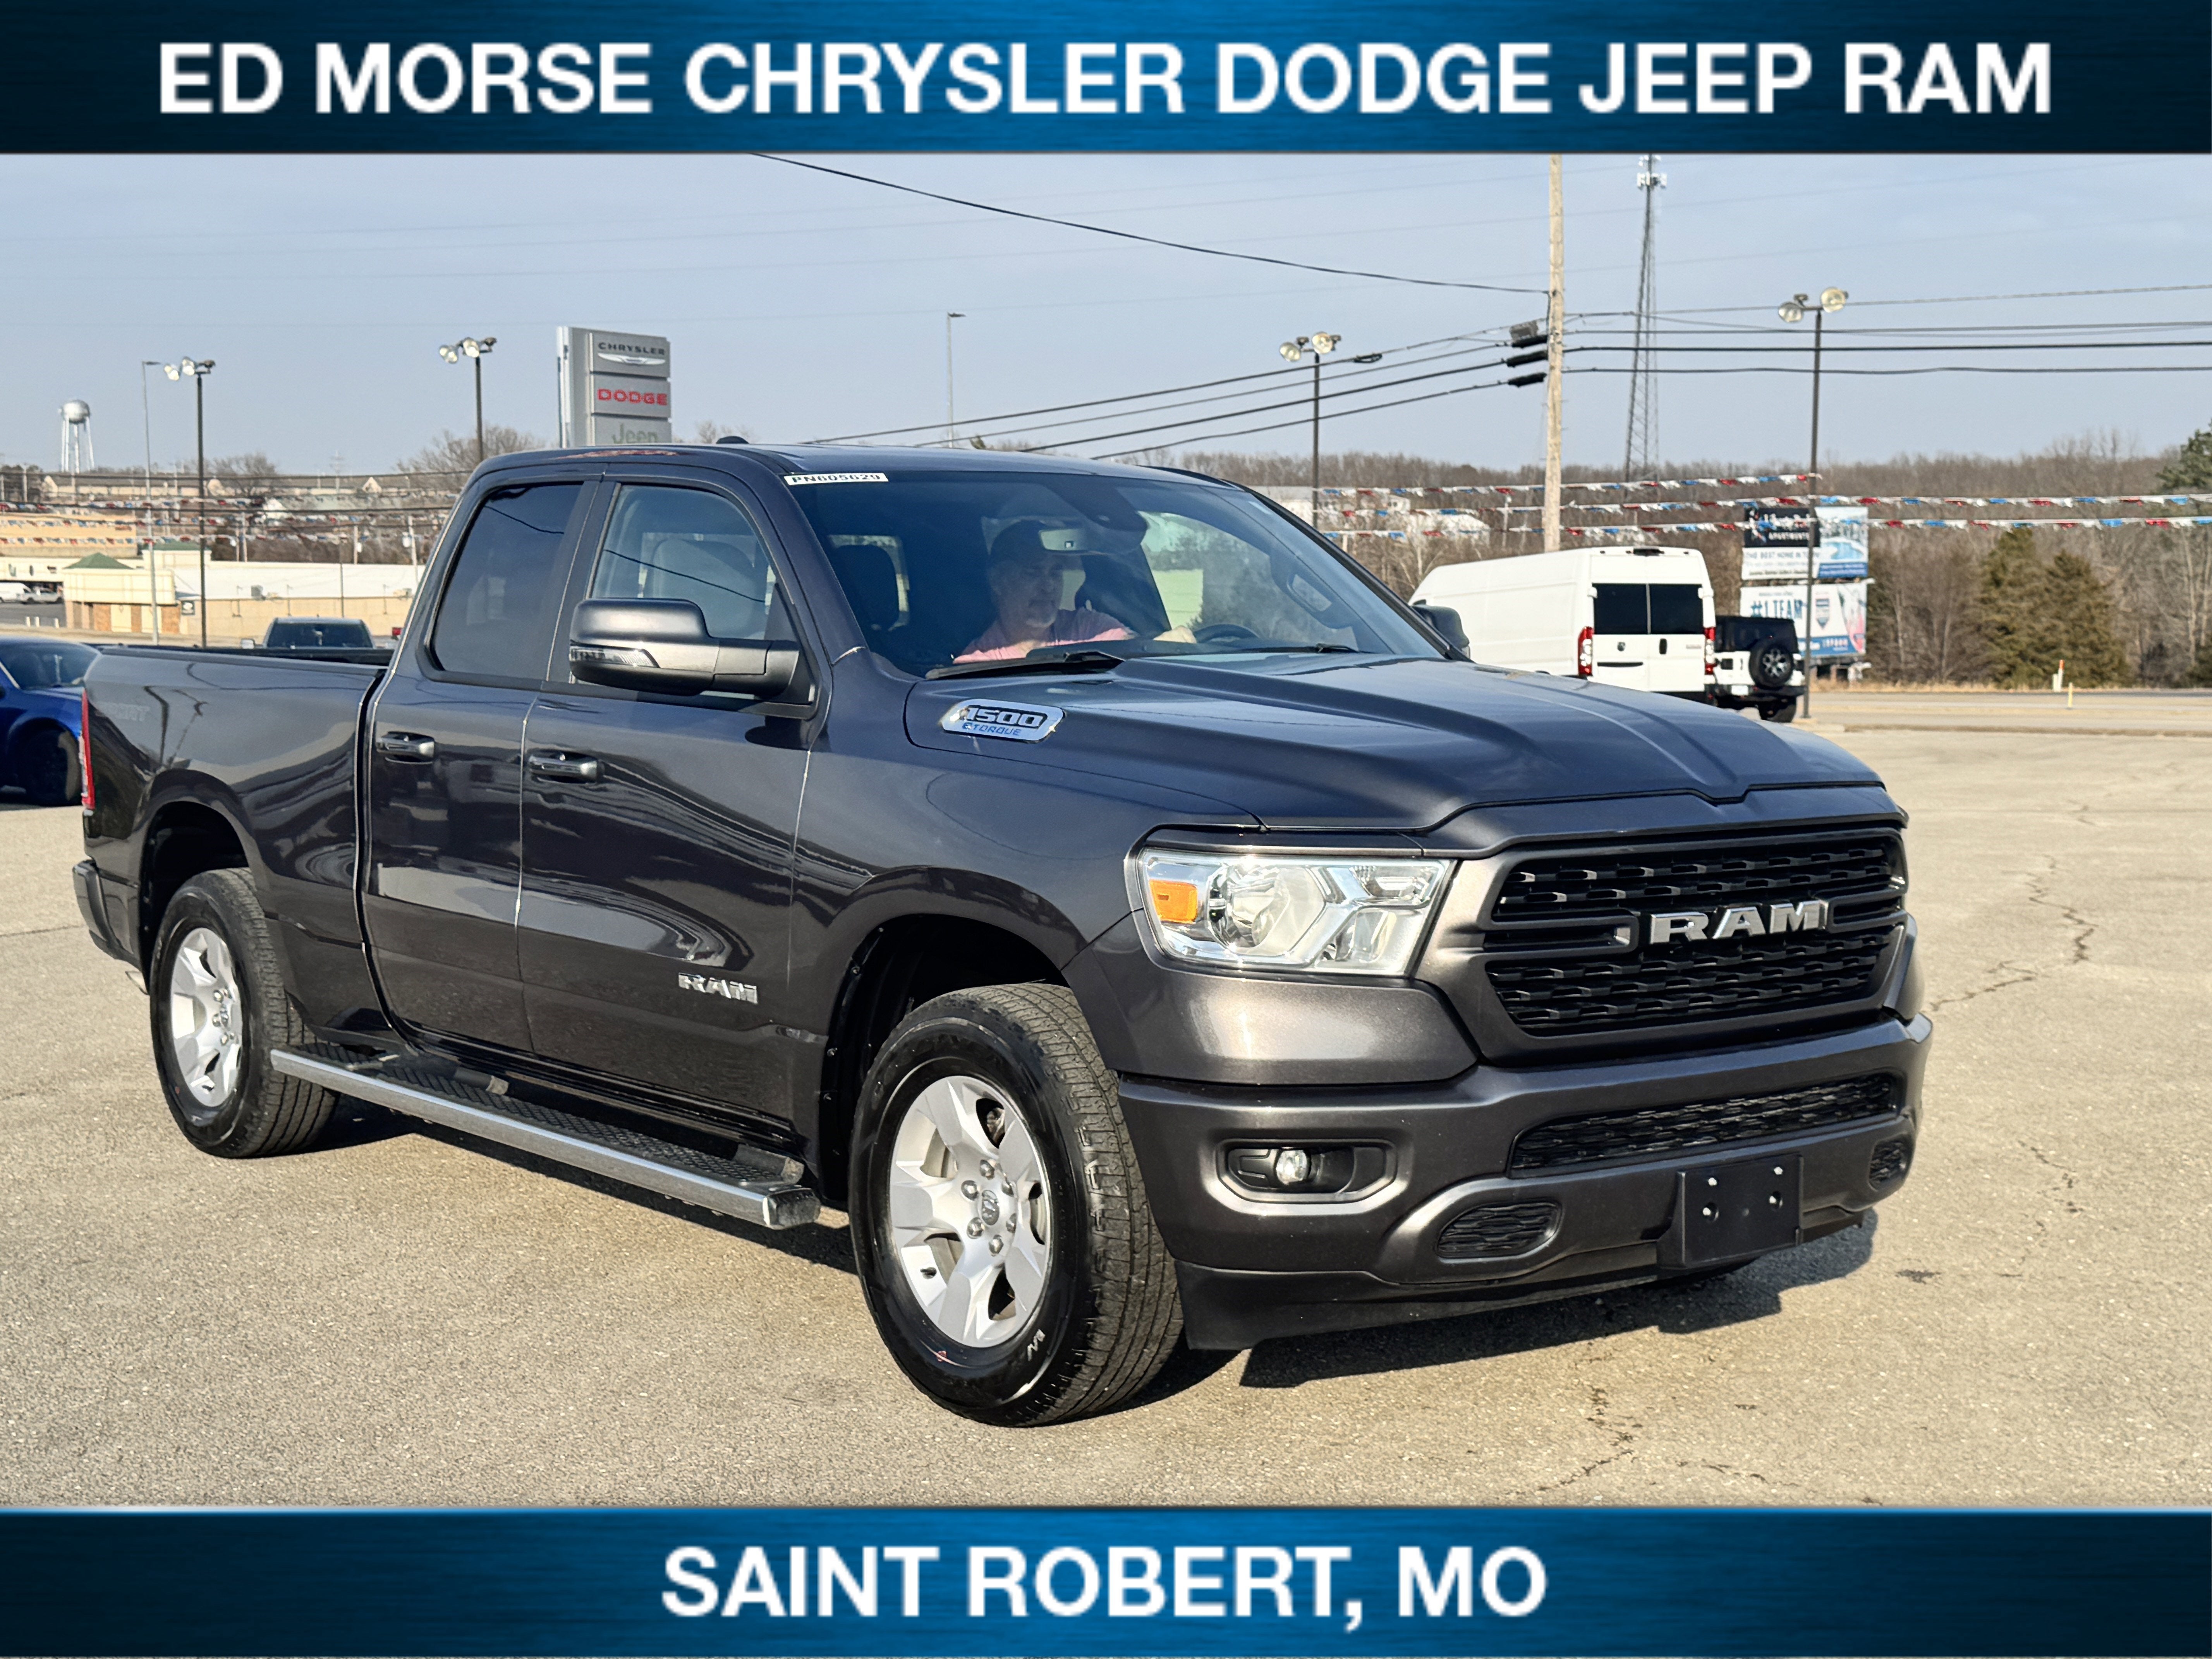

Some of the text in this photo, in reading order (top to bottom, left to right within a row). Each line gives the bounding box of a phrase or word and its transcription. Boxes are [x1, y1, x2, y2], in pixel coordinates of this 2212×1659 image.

[598, 342, 665, 355] CHRYSLER
[597, 388, 668, 406] DODGE
[792, 474, 881, 483] PN605629
[959, 707, 1044, 727] 1500
[1649, 898, 1829, 945] RAM
[678, 972, 758, 1004] RAM
